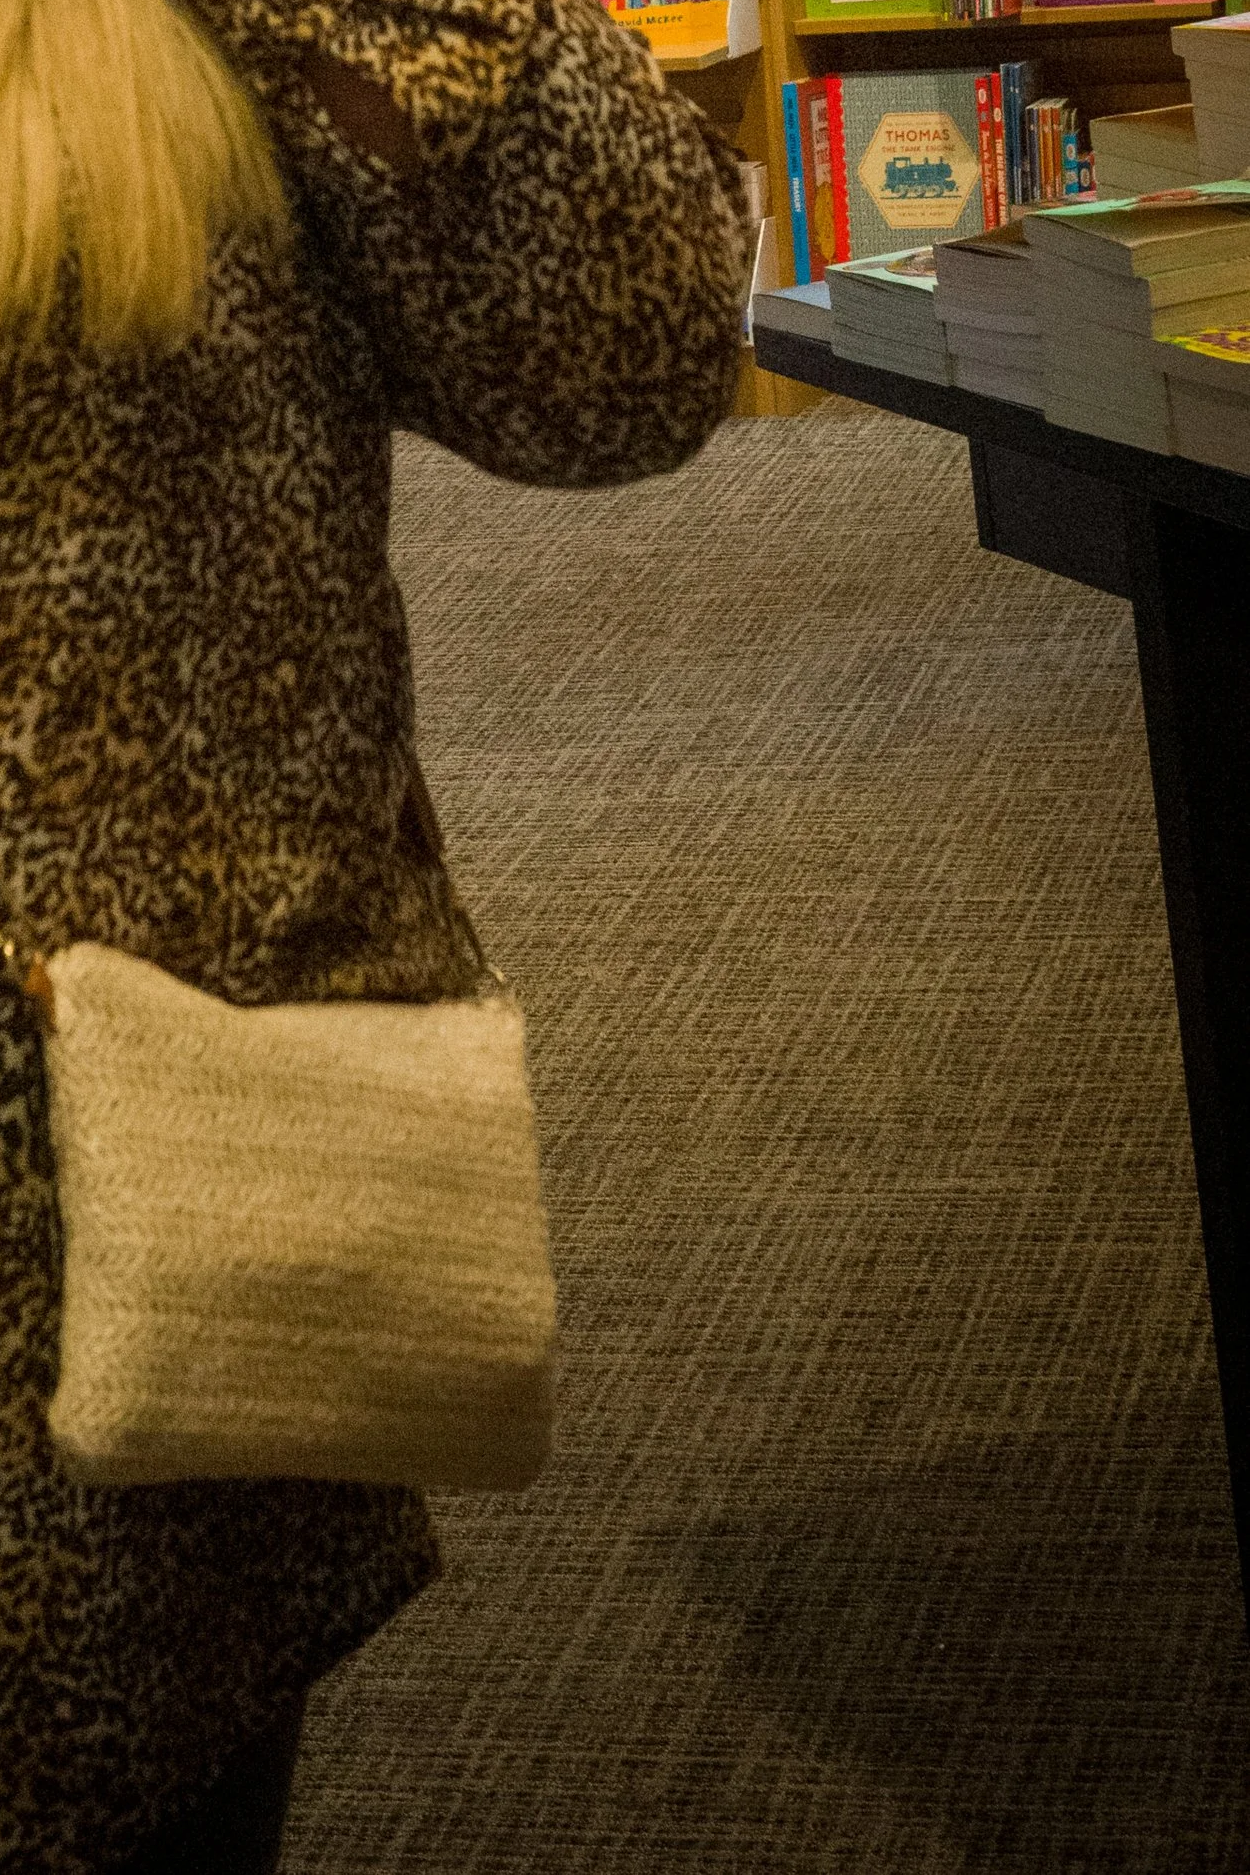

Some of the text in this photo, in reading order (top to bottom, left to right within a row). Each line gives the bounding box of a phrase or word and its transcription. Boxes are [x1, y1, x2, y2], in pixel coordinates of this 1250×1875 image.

[886, 129, 950, 142] THOMAS
[994, 138, 1004, 155] THE
[996, 154, 1005, 170] BIG
[996, 170, 1007, 193] BOOK
[791, 177, 803, 213] TREASURY
